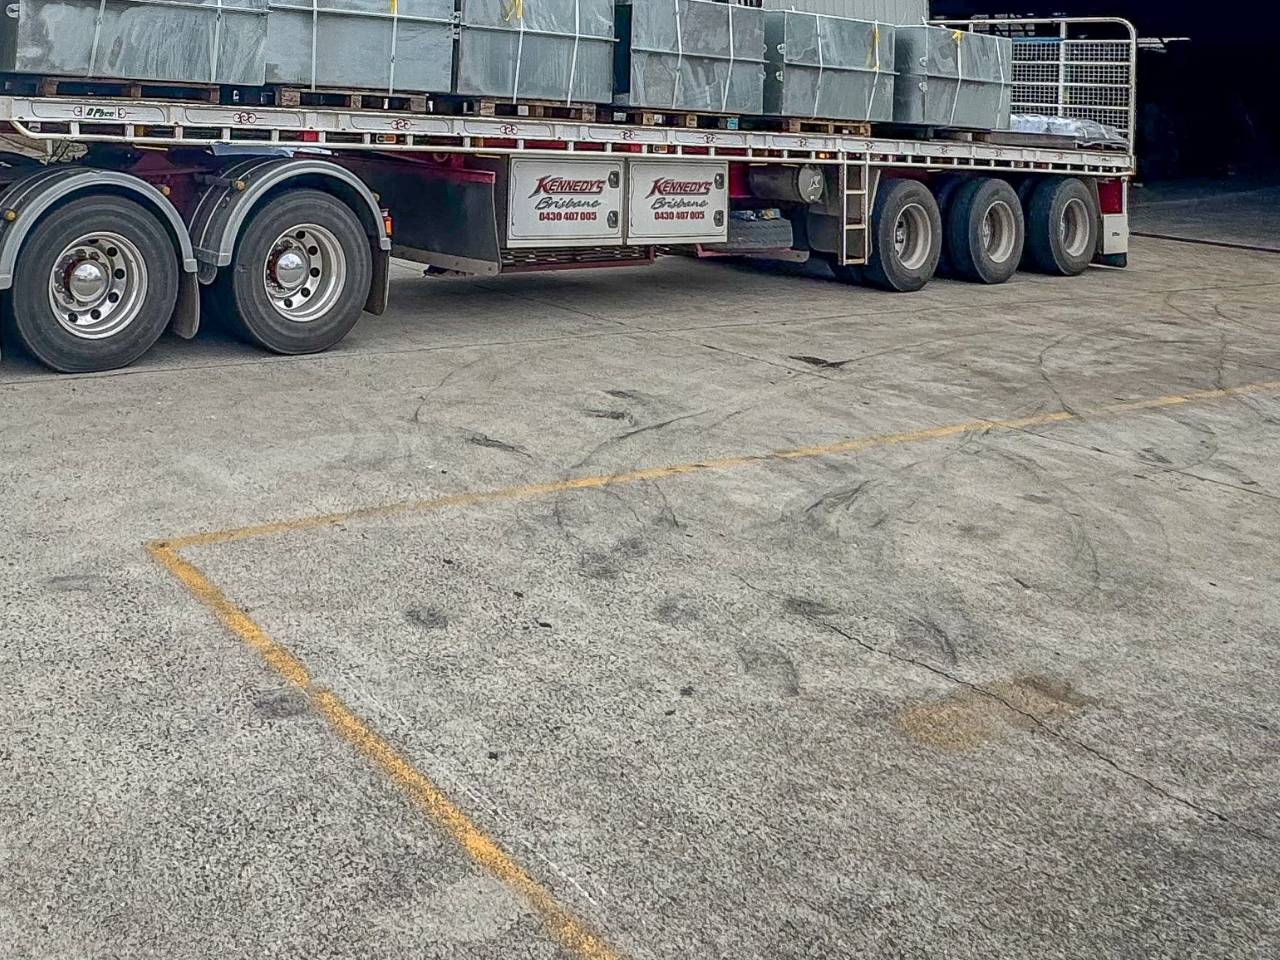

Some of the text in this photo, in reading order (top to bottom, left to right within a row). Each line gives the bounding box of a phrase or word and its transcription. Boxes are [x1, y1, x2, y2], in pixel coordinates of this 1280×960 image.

[535, 197, 601, 210] Brisbane
[651, 197, 709, 210] Brisbane
[539, 211, 597, 221] 0430 407 005
[654, 211, 705, 220] 0430 407 005
